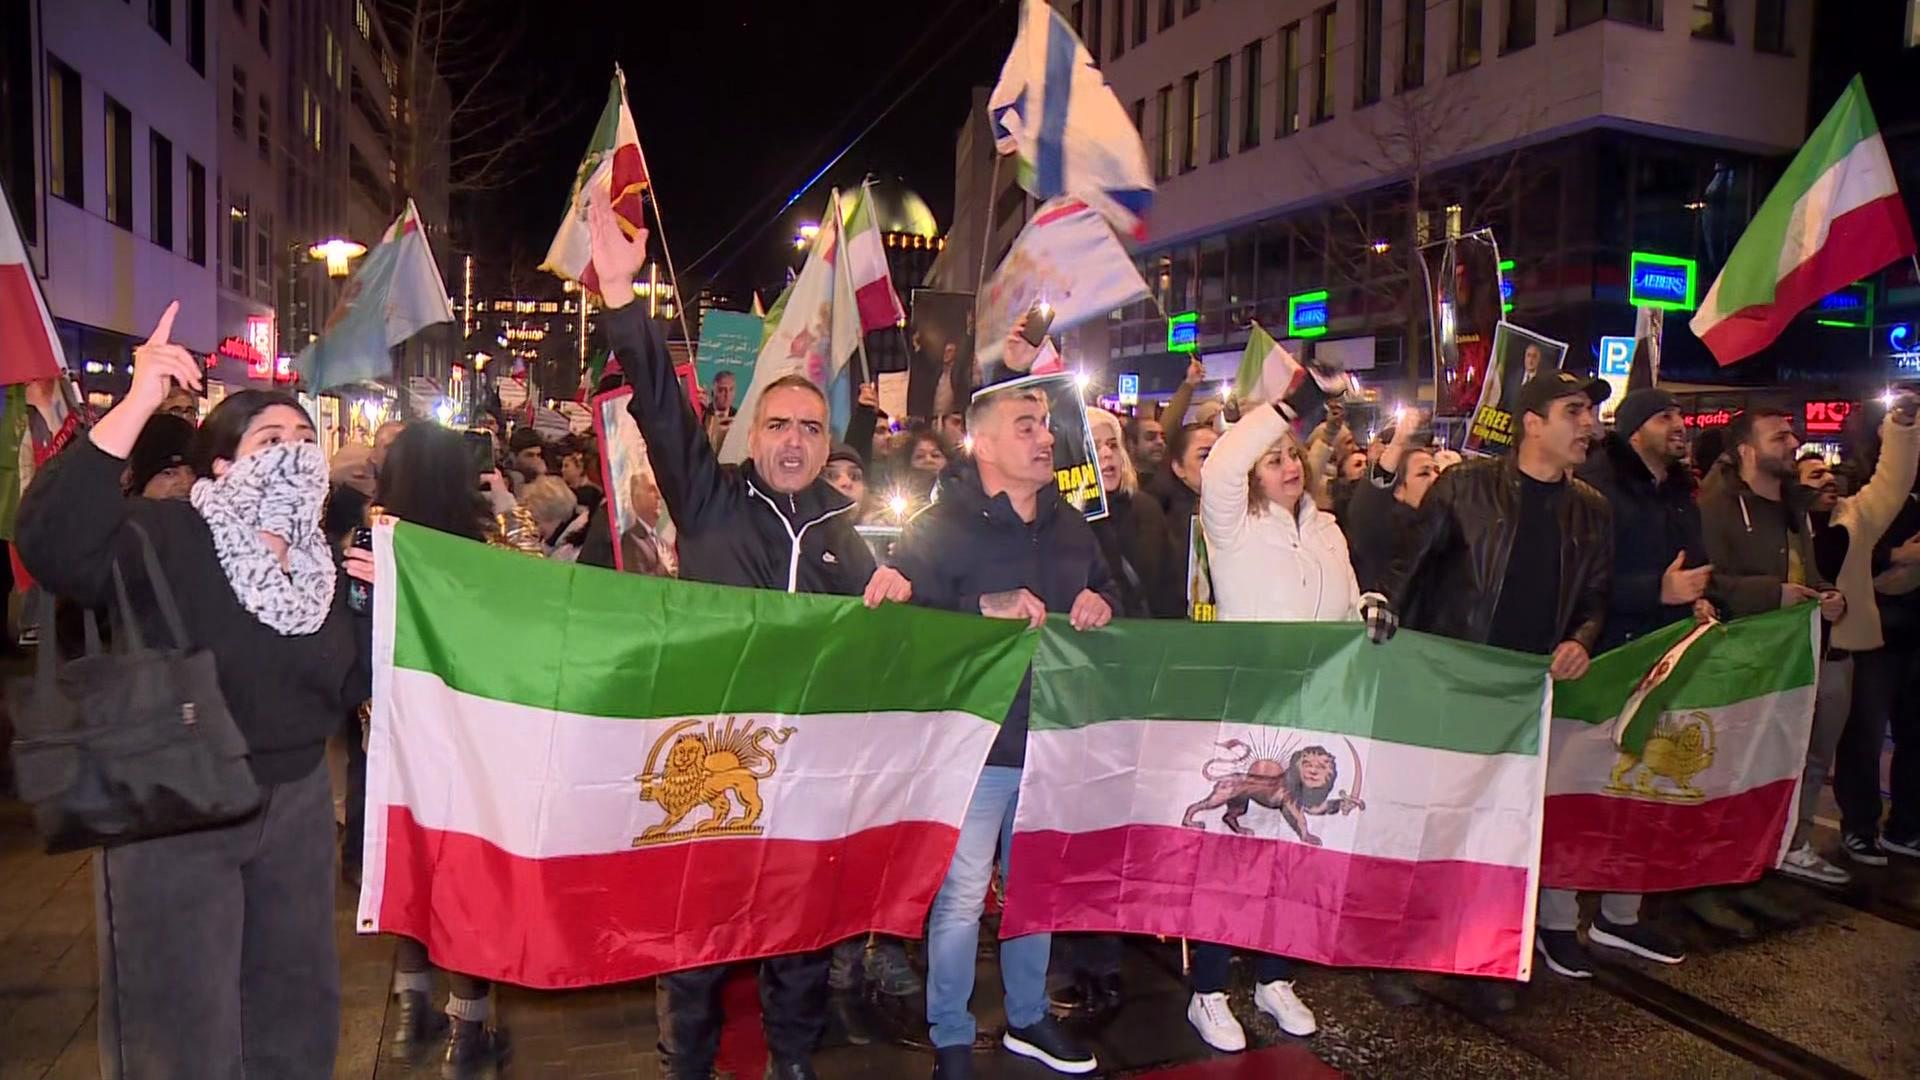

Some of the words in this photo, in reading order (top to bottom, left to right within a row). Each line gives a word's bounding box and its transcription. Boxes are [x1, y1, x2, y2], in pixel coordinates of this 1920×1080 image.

[1606, 341, 1628, 372] P
[1122, 378, 1132, 394] P
[1477, 406, 1512, 431] FREE
[1055, 463, 1097, 492] RAN
